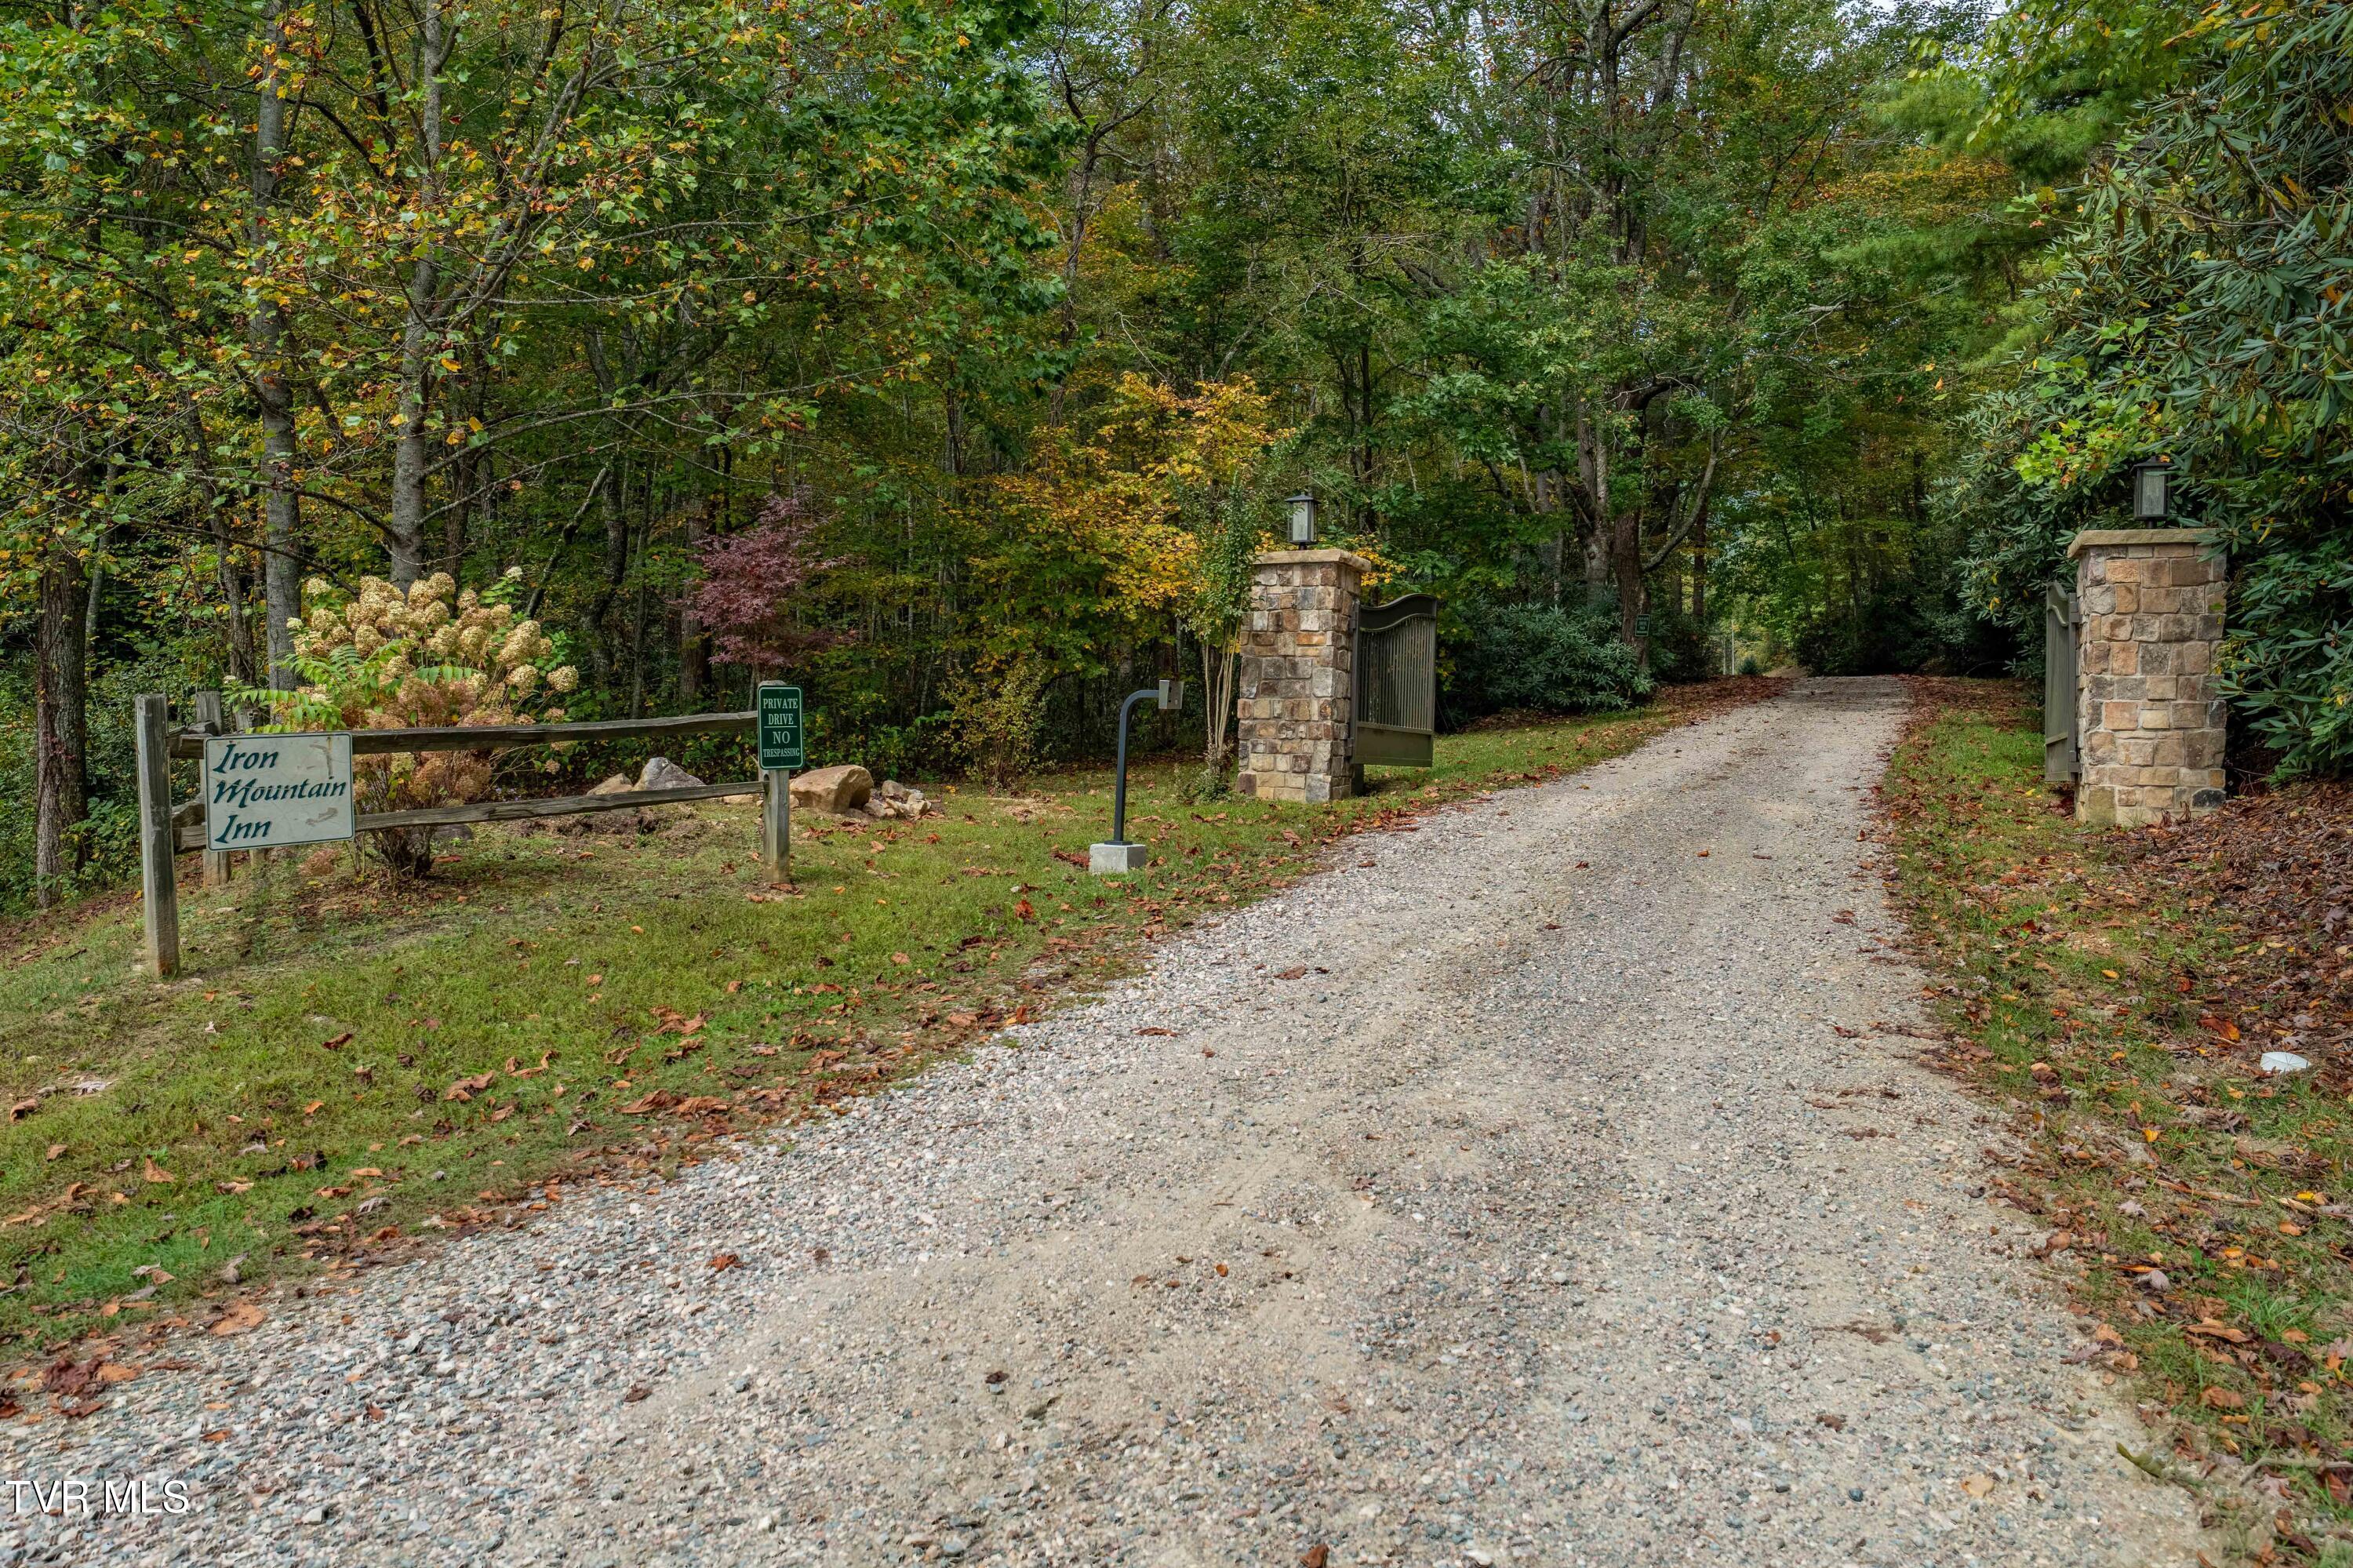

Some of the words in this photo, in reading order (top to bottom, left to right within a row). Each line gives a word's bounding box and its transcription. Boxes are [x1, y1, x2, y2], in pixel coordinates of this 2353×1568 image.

[762, 698, 798, 709] PRIVATE
[768, 713, 794, 726] DRIVE
[773, 731, 791, 744] NO
[213, 744, 278, 773] Iron
[762, 748, 800, 758] TRESPASSING
[213, 776, 346, 808] Mountain
[214, 814, 272, 844] Inn
